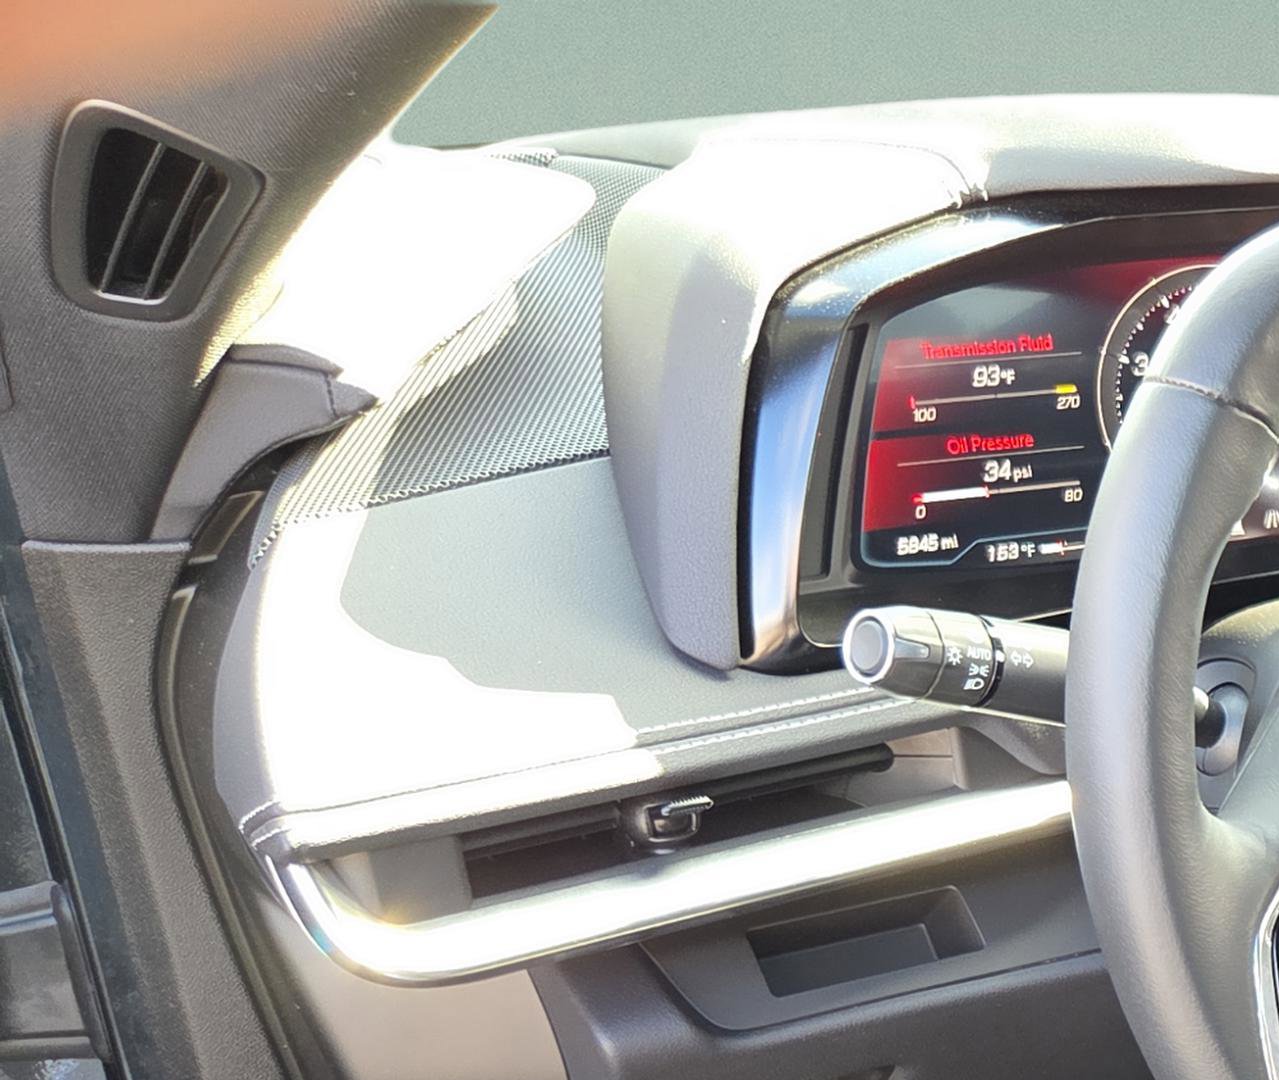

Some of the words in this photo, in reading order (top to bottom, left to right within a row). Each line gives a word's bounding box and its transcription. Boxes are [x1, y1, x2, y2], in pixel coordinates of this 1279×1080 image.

[919, 337, 1017, 360] Transmission
[1018, 333, 1054, 352] Fluid
[1056, 395, 1081, 410] 270
[912, 406, 937, 423] 100
[946, 436, 969, 455] Oil
[970, 433, 1035, 453] Pressure
[983, 459, 1012, 482] 34
[1013, 465, 1033, 482] psi
[915, 505, 927, 519] 0
[940, 534, 959, 551] mi
[966, 646, 992, 662] AUTO
